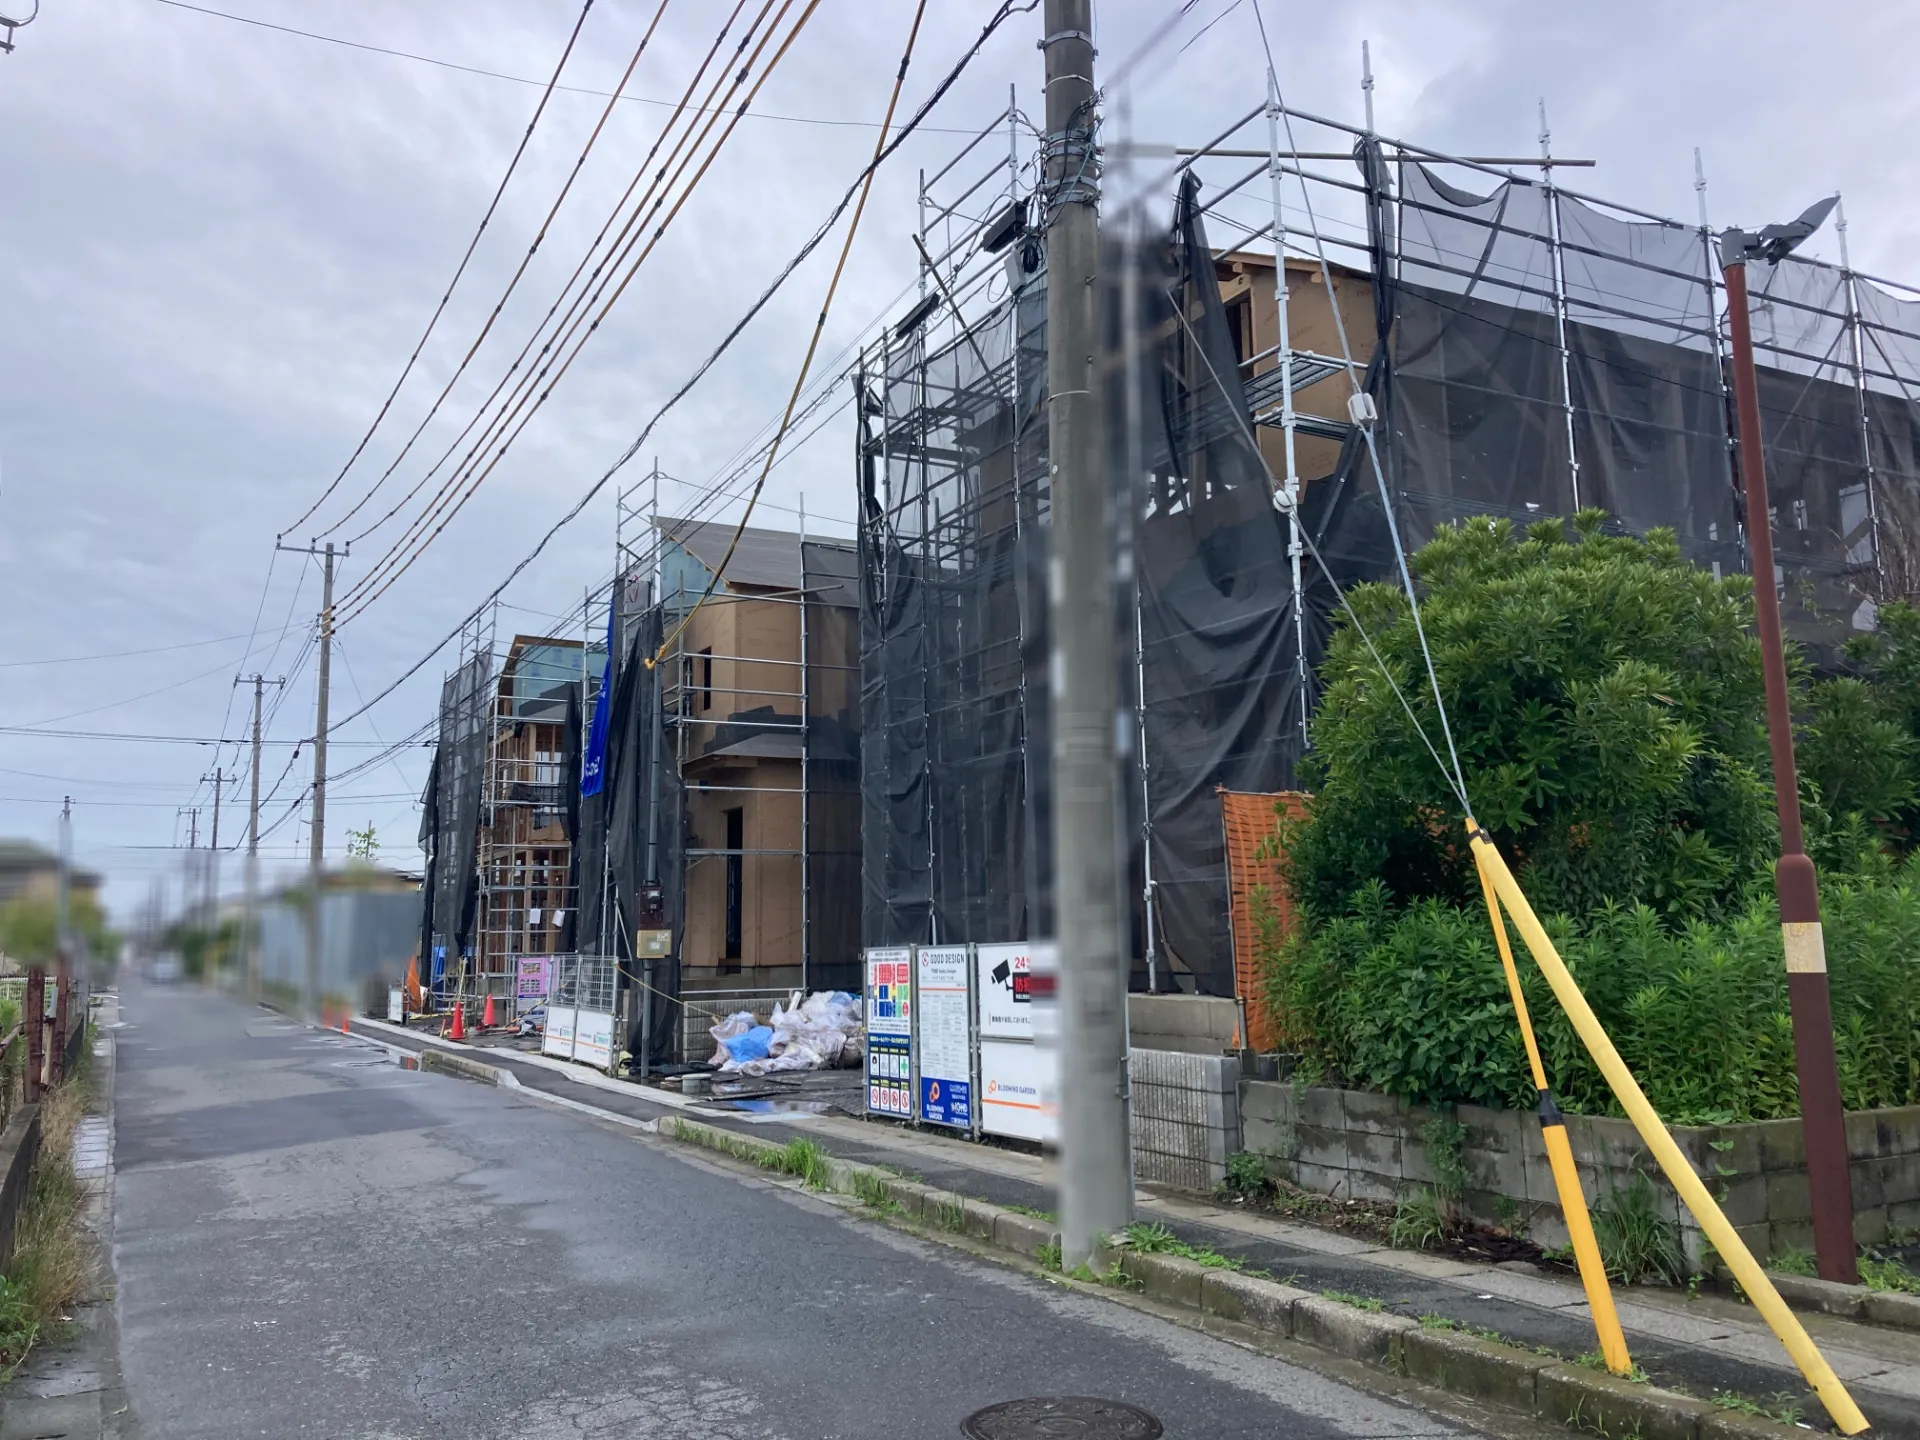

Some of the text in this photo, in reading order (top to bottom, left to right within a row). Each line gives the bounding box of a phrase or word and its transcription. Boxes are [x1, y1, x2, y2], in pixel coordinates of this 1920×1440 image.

[930, 953, 965, 964] GOOD DESIGN
[998, 1084, 1036, 1095] BLOOMING GARDEN
